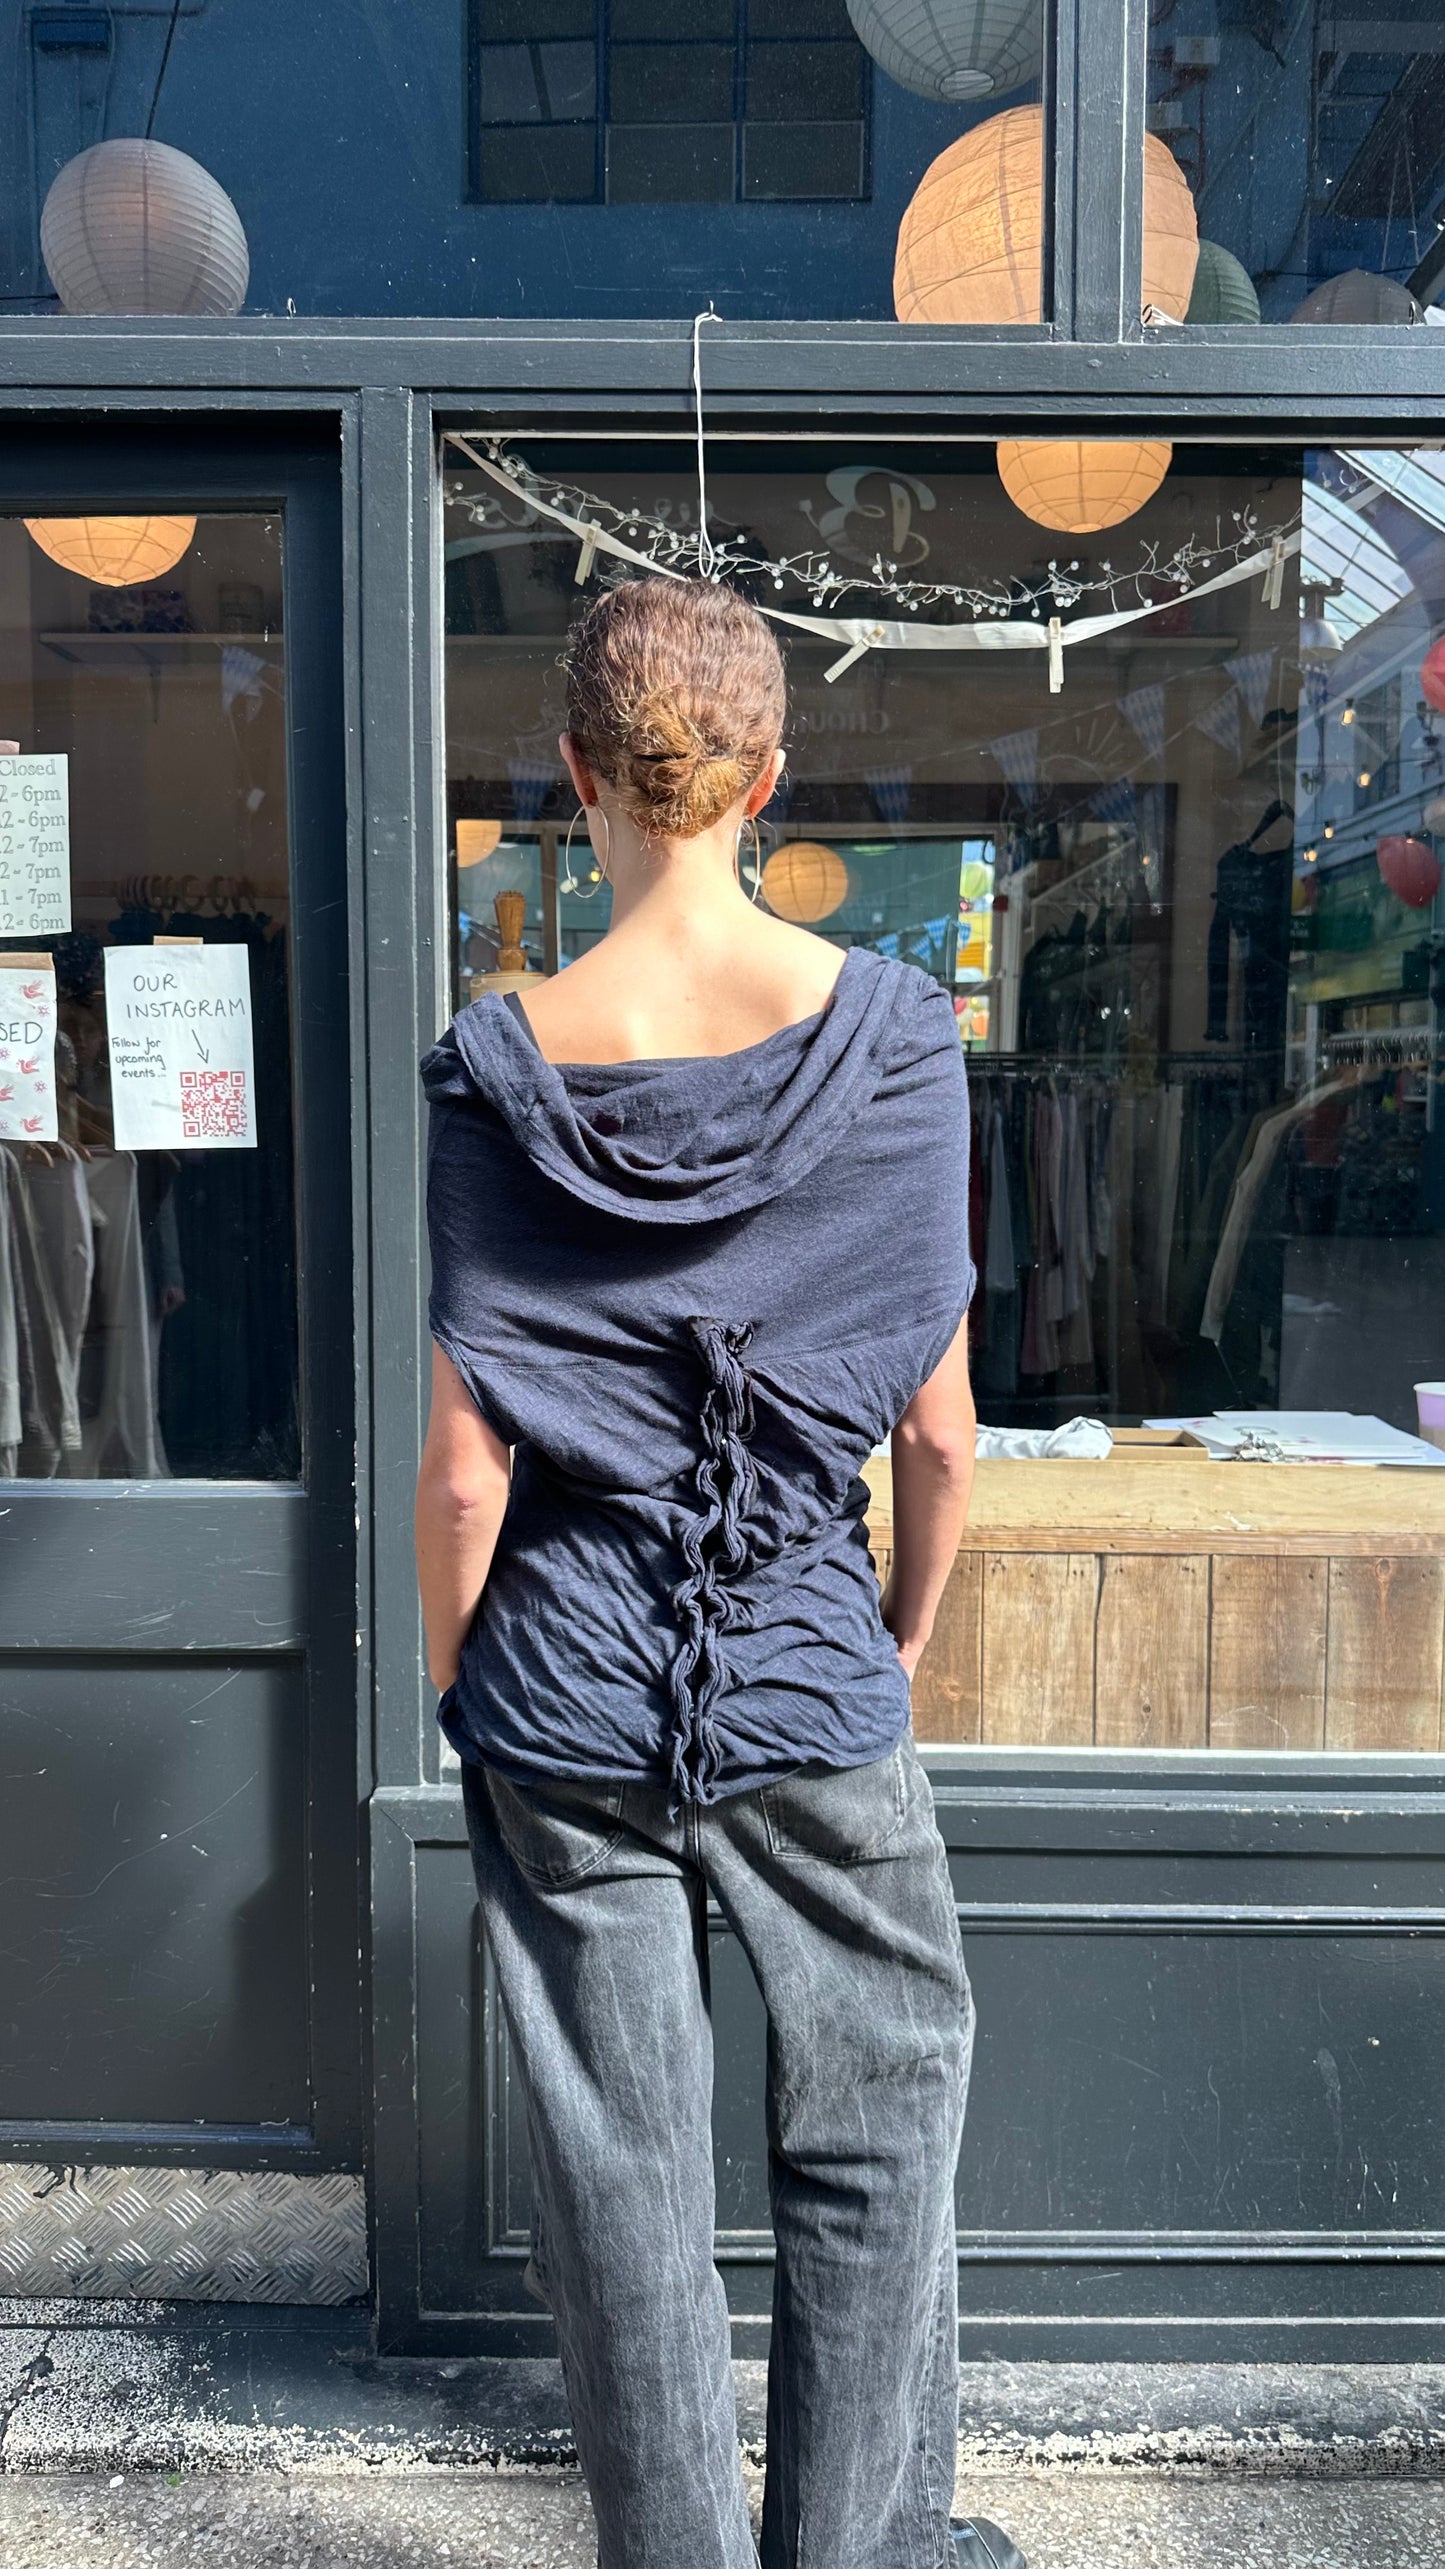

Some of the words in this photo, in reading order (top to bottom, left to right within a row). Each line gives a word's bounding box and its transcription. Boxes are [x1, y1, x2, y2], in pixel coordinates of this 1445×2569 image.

[0, 758, 57, 776] Closed
[133, 973, 178, 992] OUR
[126, 998, 246, 1019] INSTAGRAM
[111, 1037, 141, 1048] Follow
[144, 1036, 161, 1055] for
[115, 1054, 166, 1070] upcoming
